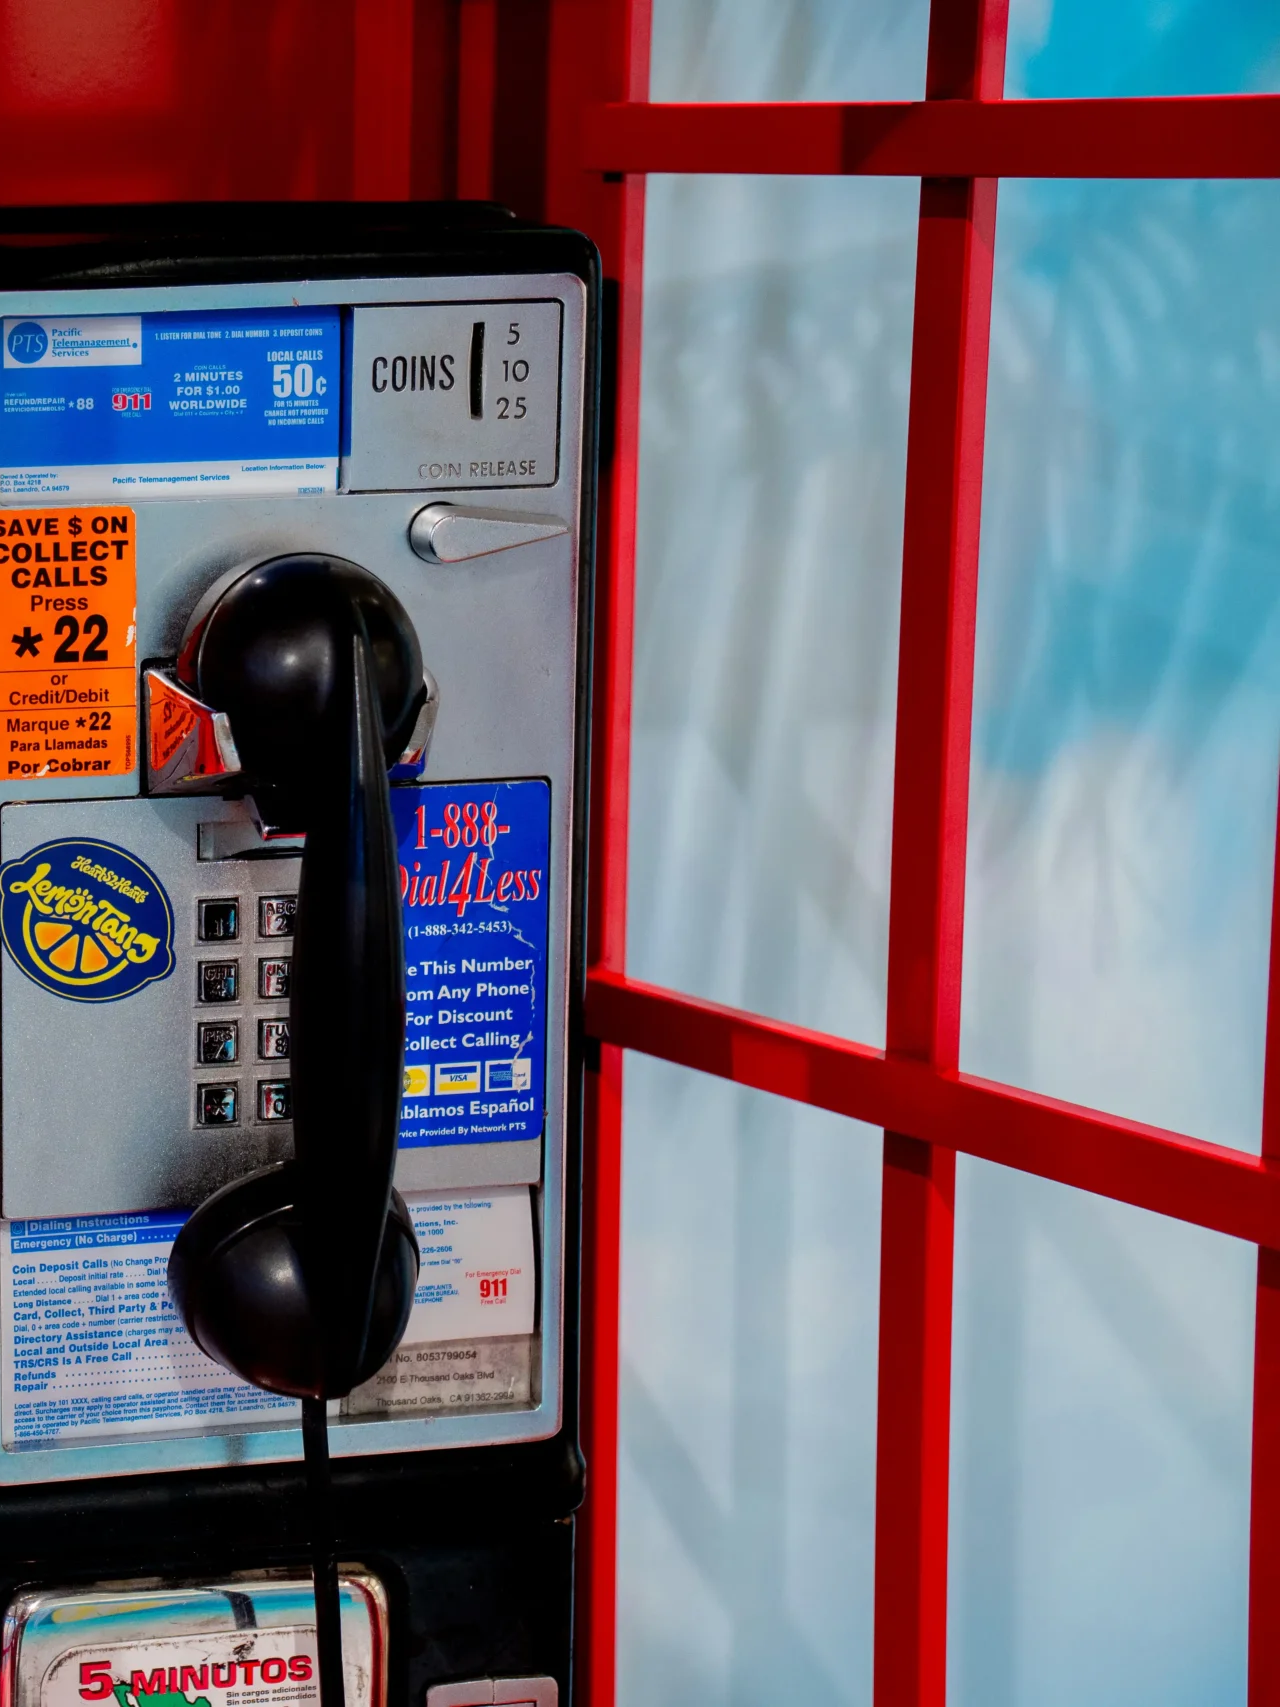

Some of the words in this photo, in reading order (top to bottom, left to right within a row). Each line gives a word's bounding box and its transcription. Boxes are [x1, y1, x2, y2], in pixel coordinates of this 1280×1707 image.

[52, 328, 82, 337] Pacific
[160, 332, 180, 340] LISTEN
[207, 331, 222, 339] TONE
[245, 330, 270, 338] NUMBER
[280, 329, 304, 337] DEPOSIT
[305, 328, 323, 336] COINS
[507, 322, 521, 345] 5
[11, 333, 44, 353] PTS
[52, 338, 130, 348] Telemanagement
[52, 349, 89, 358] Services
[267, 351, 294, 362] LOCAL
[296, 350, 323, 361] CALLS
[173, 373, 181, 382] 2
[185, 371, 244, 382] MINUTES
[372, 355, 455, 393] COINS
[502, 359, 530, 382] 10
[176, 386, 202, 396] FOR
[206, 385, 241, 396] $1.00
[4, 397, 65, 406] REFUND/REPAIR
[112, 393, 152, 411] 911
[169, 399, 248, 410] WORLDWIDE
[274, 400, 285, 408] FOR
[286, 400, 293, 408] 15
[293, 399, 319, 407] MINUTES
[496, 397, 527, 420] 25
[264, 409, 287, 417] CHANGE
[300, 408, 328, 416] PROVIDED
[307, 417, 324, 425] CALLS
[269, 464, 304, 472] Information
[418, 463, 461, 480] COIN
[469, 460, 537, 477] RELEASE
[112, 476, 136, 484] Pacific
[138, 475, 198, 484] Telemanagement
[68, 515, 82, 537] $
[91, 516, 127, 534] ON
[11, 566, 107, 589] CALLS
[31, 595, 88, 612] Press
[50, 674, 68, 686] or
[9, 688, 110, 706] Credit/Debit
[6, 718, 70, 733] Marque
[10, 740, 40, 752] Para
[45, 738, 108, 751] Llamadas
[8, 760, 40, 774] Por
[48, 758, 111, 773] Cobrar
[415, 801, 510, 849] 1-888-
[275, 916, 287, 932] 2
[408, 921, 512, 939] (1-888-342-5453)
[420, 961, 456, 976] This
[461, 957, 533, 974] Number
[276, 978, 287, 994] 5
[437, 984, 471, 1002] Any
[476, 983, 530, 997] Phone
[405, 1013, 433, 1027] For
[438, 1008, 513, 1025] Discount
[275, 1038, 287, 1053] 8
[461, 1032, 520, 1049] Calling
[449, 1074, 468, 1083] VISA
[470, 1097, 534, 1118] Español
[420, 1127, 456, 1137] Provided
[458, 1126, 469, 1136] By
[471, 1124, 507, 1134] Network
[509, 1122, 526, 1131] PTS
[417, 1205, 442, 1213] provided
[29, 1221, 72, 1231] Dialing
[77, 1215, 150, 1229] Instructions
[428, 1228, 444, 1236] 1000
[14, 1238, 71, 1250] Emergency
[75, 1235, 93, 1246] (No
[96, 1231, 137, 1244] Charge)
[12, 1265, 36, 1274] Coin
[39, 1261, 79, 1273] Deposit
[82, 1259, 108, 1269] Calls
[125, 1258, 152, 1267] Change
[477, 1270, 508, 1278] Emergency
[13, 1278, 35, 1286] Local
[59, 1274, 86, 1283] Deposit
[88, 1272, 107, 1280] initial
[147, 1268, 160, 1276] Dial
[13, 1288, 47, 1297] Extended
[49, 1286, 65, 1294] local
[68, 1285, 91, 1293] calling
[94, 1282, 125, 1291] available
[480, 1278, 507, 1298] 911
[13, 1301, 33, 1309] Long
[36, 1299, 72, 1307] Distance
[96, 1294, 109, 1302] Dial
[141, 1291, 159, 1299] code
[13, 1311, 41, 1321] Card,
[44, 1307, 85, 1319] Collect,
[88, 1305, 115, 1316] Third
[119, 1303, 146, 1314] Party
[13, 1324, 30, 1333] Dial,
[44, 1322, 61, 1330] area
[62, 1320, 80, 1329] code
[88, 1318, 115, 1327] number
[117, 1316, 143, 1326] (carrier
[13, 1333, 62, 1345] Directory
[65, 1329, 123, 1341] Assistance
[125, 1328, 156, 1338] (charges
[158, 1326, 173, 1335] may
[14, 1347, 43, 1357] Local
[46, 1345, 66, 1355] and
[68, 1342, 109, 1353] Outside
[112, 1339, 141, 1349] Local
[144, 1337, 168, 1347] Area
[14, 1357, 59, 1369] TRS/CRS
[62, 1356, 72, 1365] Is
[75, 1355, 83, 1364] A
[85, 1353, 109, 1363] Free
[111, 1351, 132, 1361] Call
[396, 1353, 413, 1363] No.
[416, 1350, 477, 1362] 8053799054
[14, 1371, 57, 1381] Refunds
[400, 1374, 407, 1383] E
[410, 1373, 450, 1383] Thousand
[453, 1371, 474, 1381] Oaks
[477, 1371, 495, 1379] Blvd
[14, 1382, 48, 1393] Repair
[376, 1397, 417, 1407] Thousand
[420, 1395, 444, 1404] Oaks,
[450, 1394, 462, 1403] CA
[78, 1660, 114, 1701] 5
[131, 1654, 313, 1698] MINUTOS
[241, 1689, 269, 1697] cargos
[272, 1684, 317, 1694] adicionales
[242, 1697, 269, 1705] costos
[271, 1693, 317, 1702] escondidos
